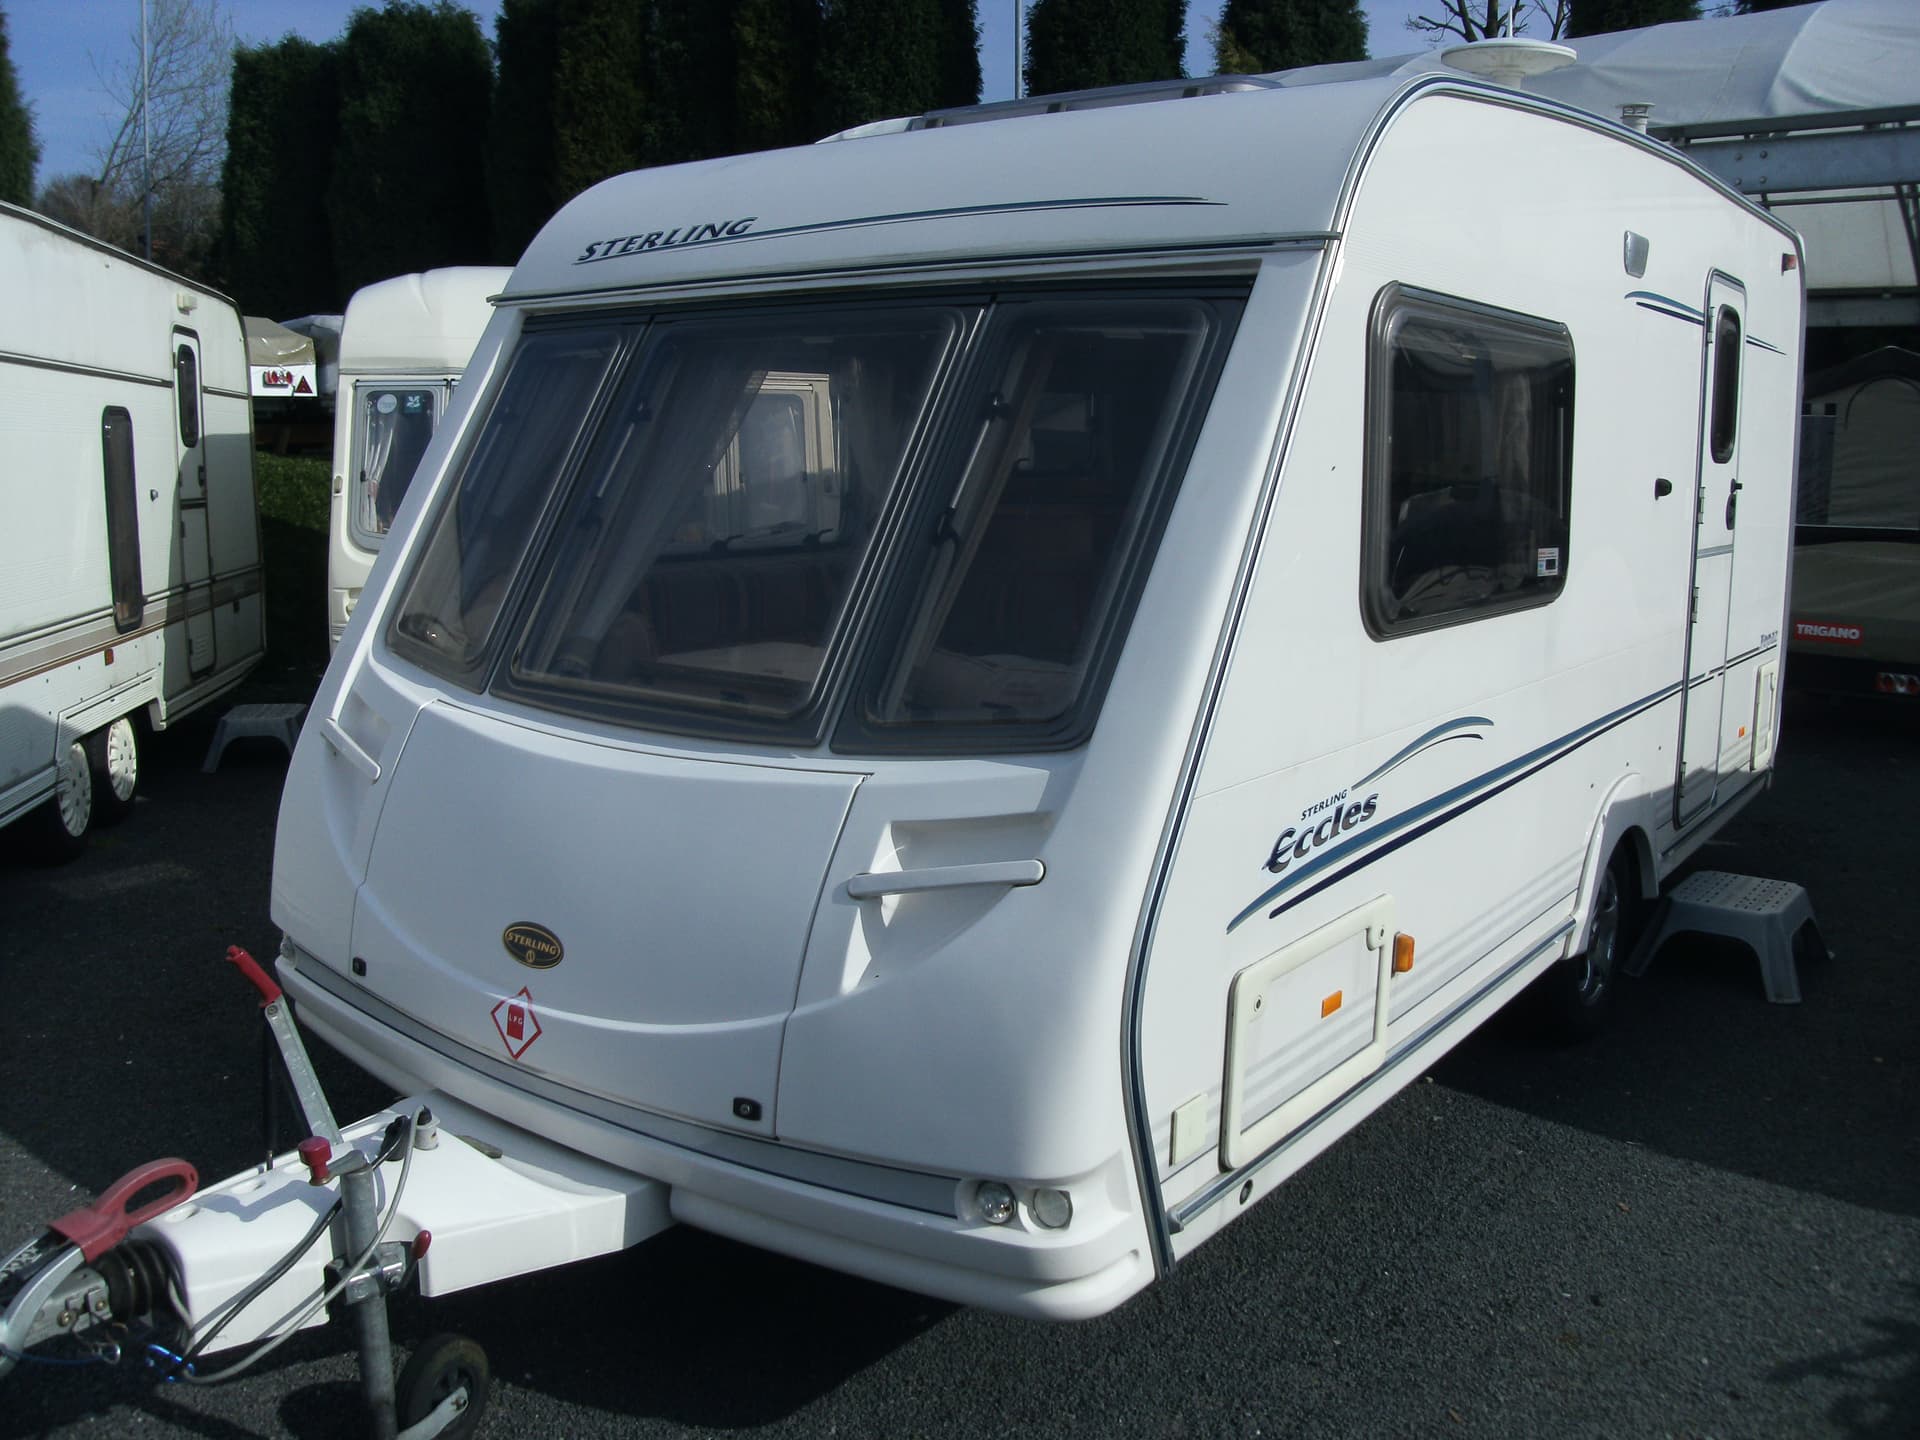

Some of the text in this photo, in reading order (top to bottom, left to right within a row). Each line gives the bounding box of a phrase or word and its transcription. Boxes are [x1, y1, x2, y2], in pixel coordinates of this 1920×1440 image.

[577, 216, 759, 262] STERLING
[1796, 623, 1861, 640] TRIGANO
[1300, 789, 1348, 821] STERLING
[1261, 793, 1379, 873] Eccles
[506, 932, 558, 955] STERLING
